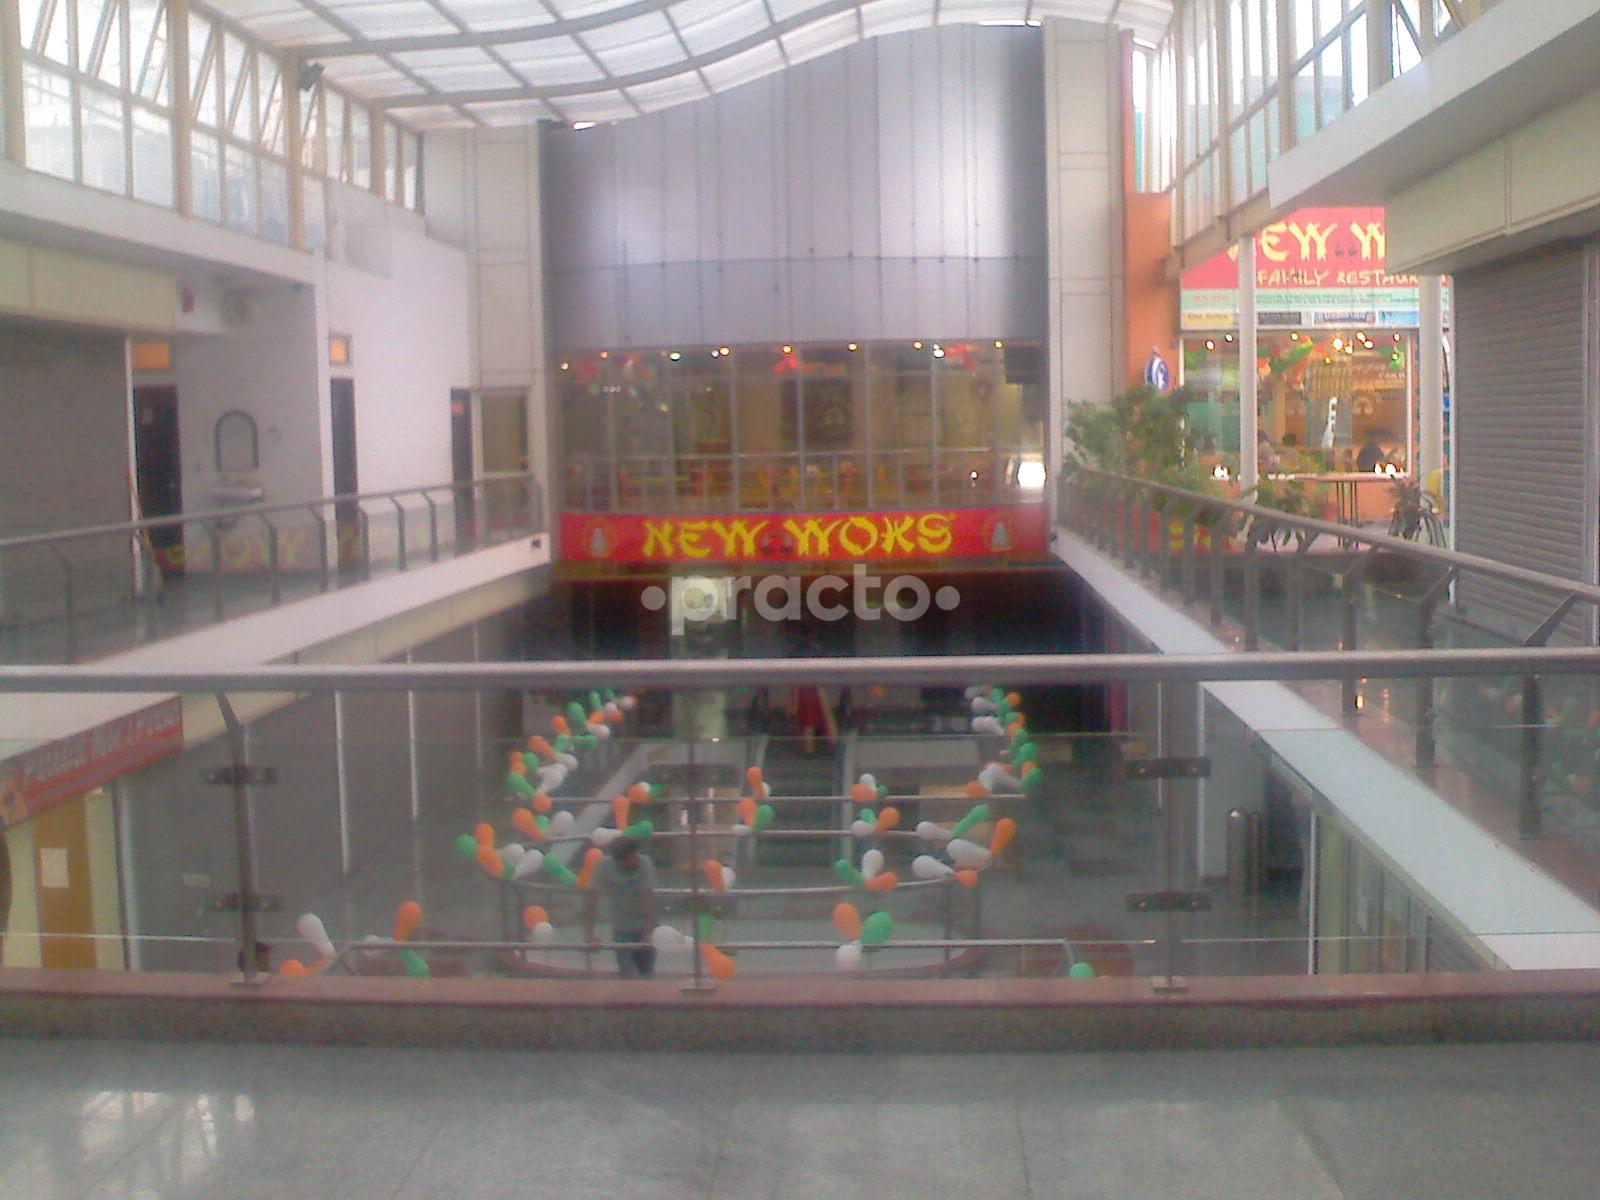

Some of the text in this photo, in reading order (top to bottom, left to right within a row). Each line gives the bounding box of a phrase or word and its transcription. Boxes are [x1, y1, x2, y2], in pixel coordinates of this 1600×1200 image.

[1228, 221, 1337, 262] EW
[1257, 269, 1329, 286] FAMILY
[642, 513, 953, 557] NEW WOKS
